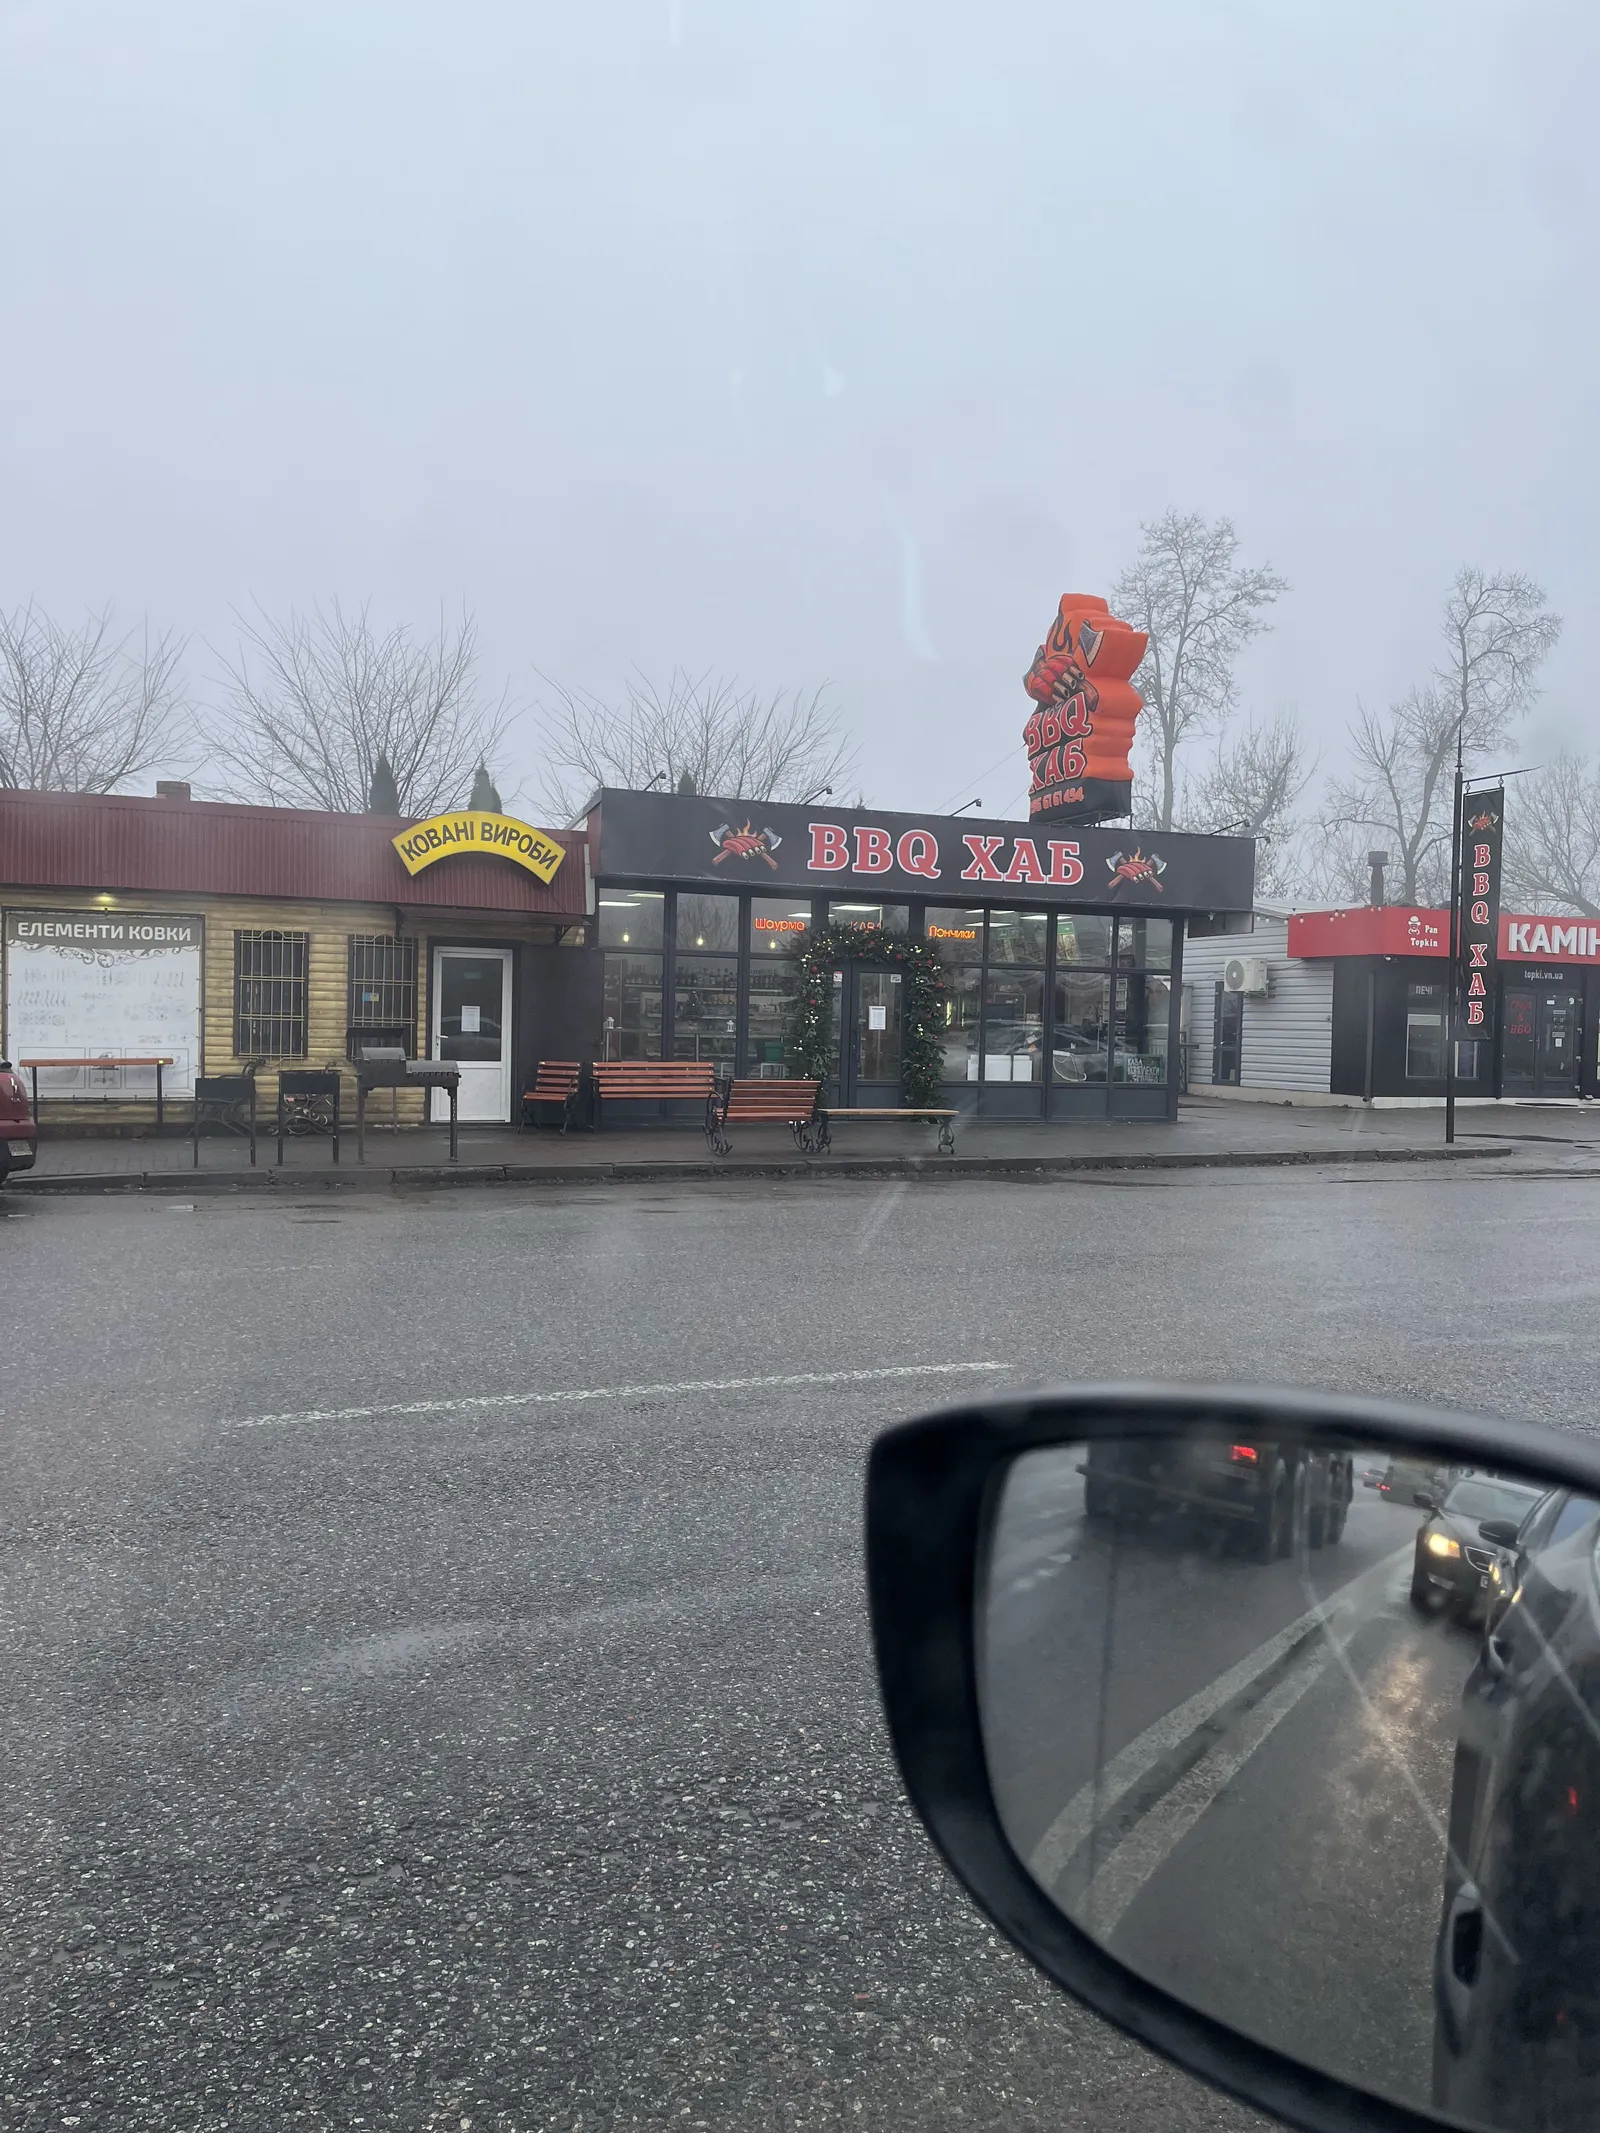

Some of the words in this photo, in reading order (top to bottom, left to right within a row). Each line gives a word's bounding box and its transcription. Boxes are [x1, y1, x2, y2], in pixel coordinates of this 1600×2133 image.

[1026, 691, 1092, 758] BBQ
[1028, 738, 1087, 794] ХАБ
[401, 821, 474, 862] КОВАНІ
[480, 821, 559, 871] ВИРОБИ
[807, 823, 942, 880] BBQ
[961, 834, 1084, 886] ХАБ
[1471, 844, 1491, 924] BBQ
[17, 922, 124, 939] ЕЛЕМЕНТИ
[128, 925, 192, 942] КОВКИ
[755, 917, 806, 932] Шаурма
[929, 925, 976, 939] Пончики
[1425, 925, 1438, 934] Pan
[1410, 937, 1438, 947] Topkin
[1468, 944, 1488, 1025] ХАБ
[1524, 970, 1564, 981] topki.vn.ua
[1415, 985, 1433, 995] ПЕЧІ
